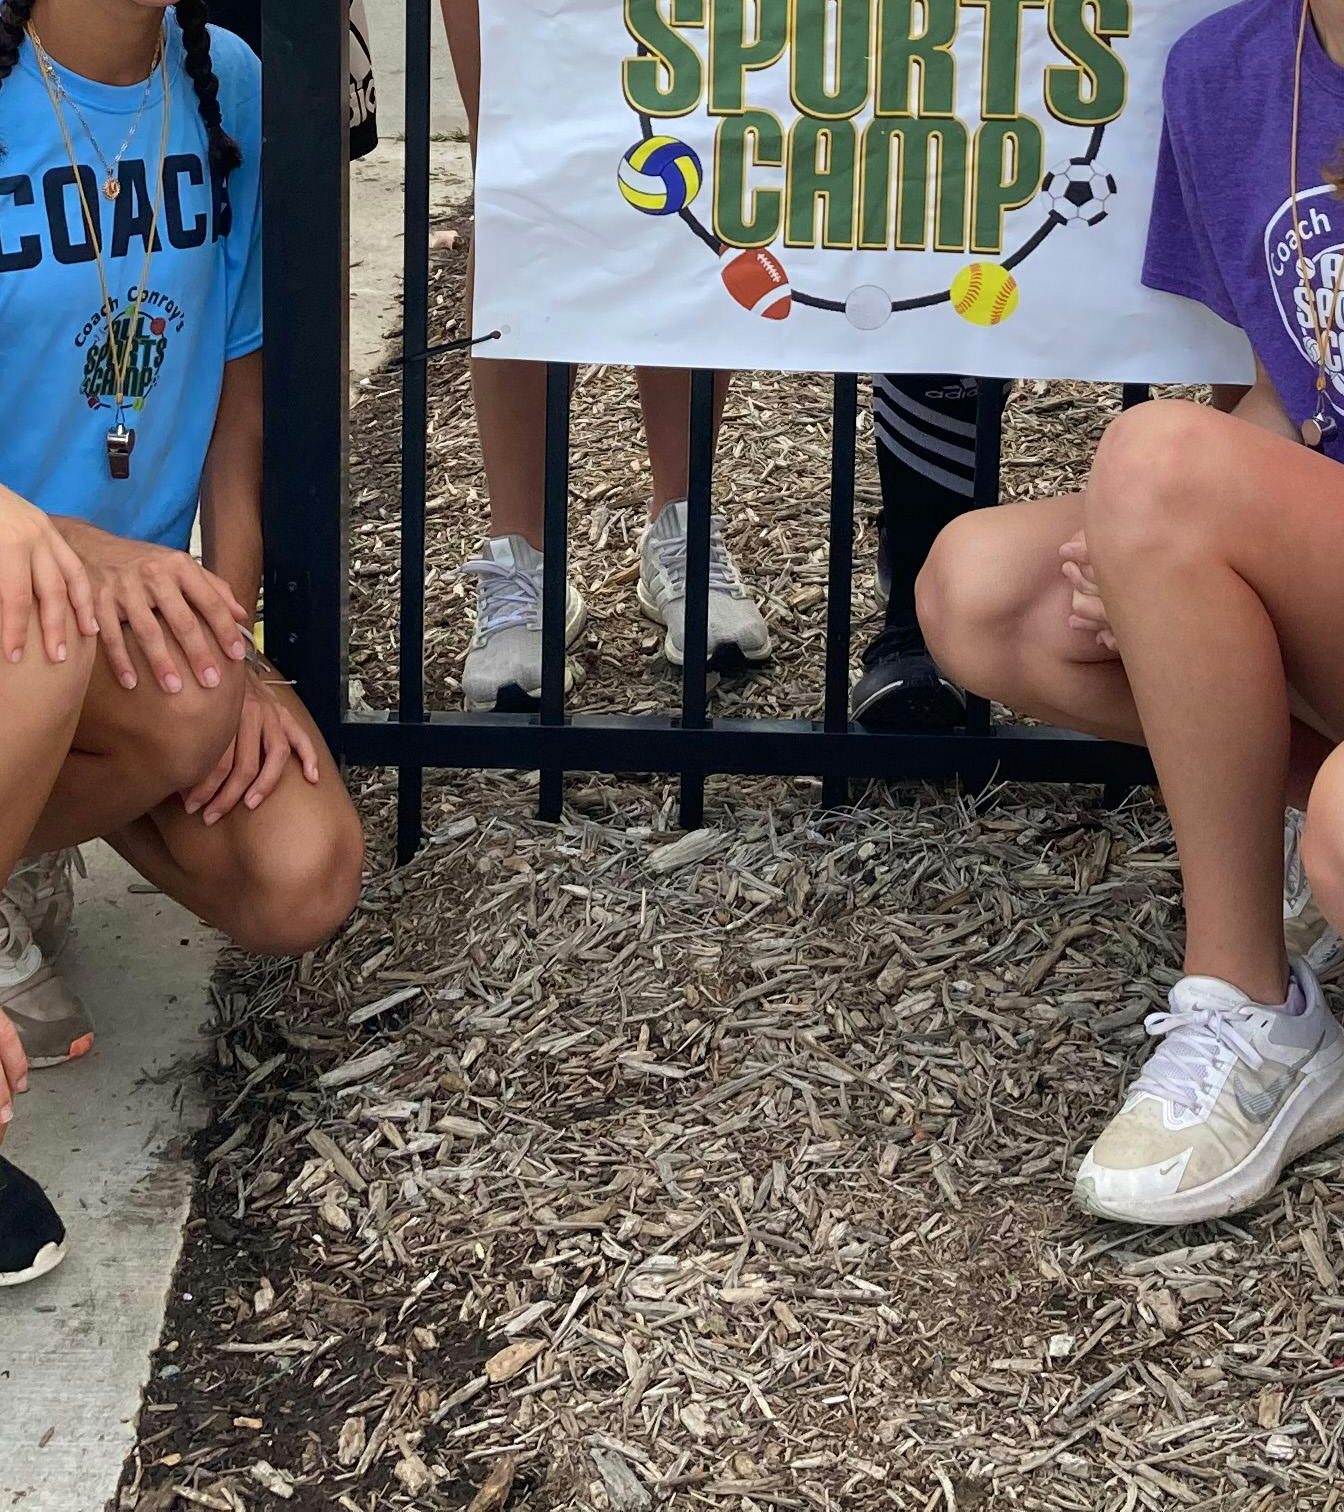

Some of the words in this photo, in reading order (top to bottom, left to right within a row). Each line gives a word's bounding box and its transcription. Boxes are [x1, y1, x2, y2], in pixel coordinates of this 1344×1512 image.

[711, 105, 1047, 255] CAMP
[1269, 207, 1332, 277] Coach
[74, 295, 119, 348] Coach
[127, 285, 185, 333] Conroy's
[107, 316, 151, 341] ALL
